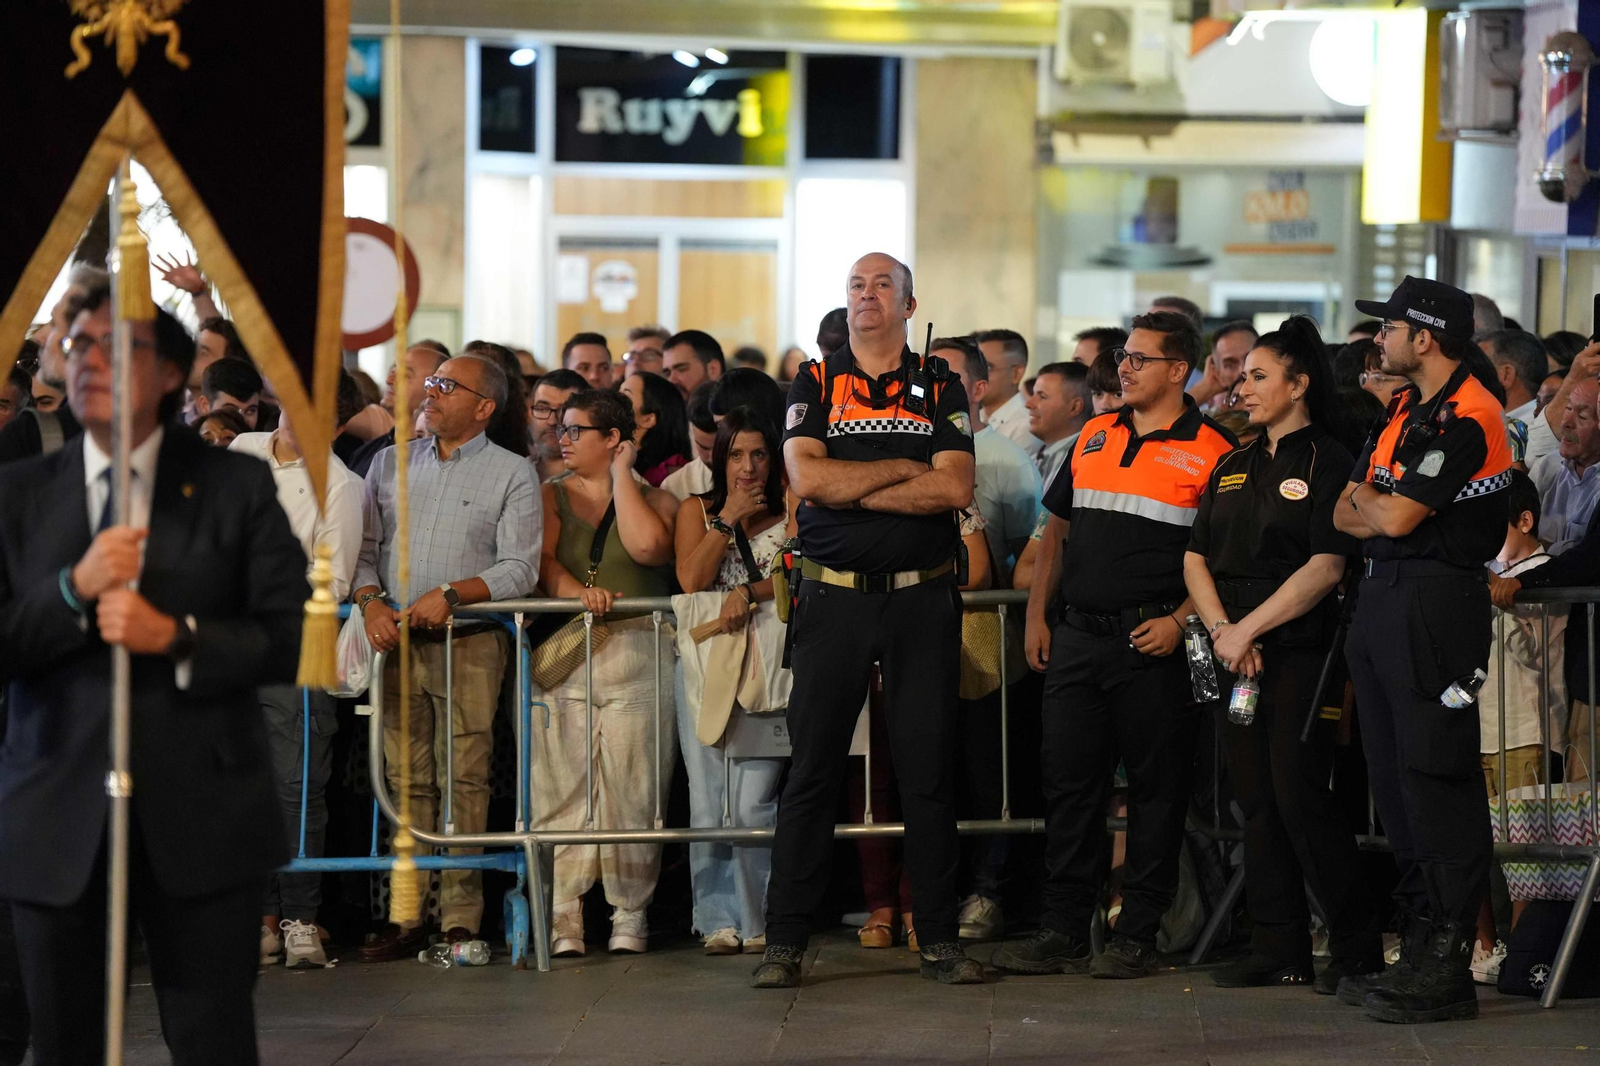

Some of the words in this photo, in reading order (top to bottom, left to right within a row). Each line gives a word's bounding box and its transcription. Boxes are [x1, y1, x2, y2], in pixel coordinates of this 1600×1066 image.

[577, 87, 763, 146] Ruyvi
[1434, 318, 1446, 329] CIVIL
[1160, 446, 1206, 466] PROTECCIÓN
[1170, 454, 1188, 464] CIVIL
[1154, 456, 1200, 476] VOLUNTARIADO
[1282, 485, 1305, 496] SEGURIDAD
[1285, 480, 1307, 491] VIGILANTE
